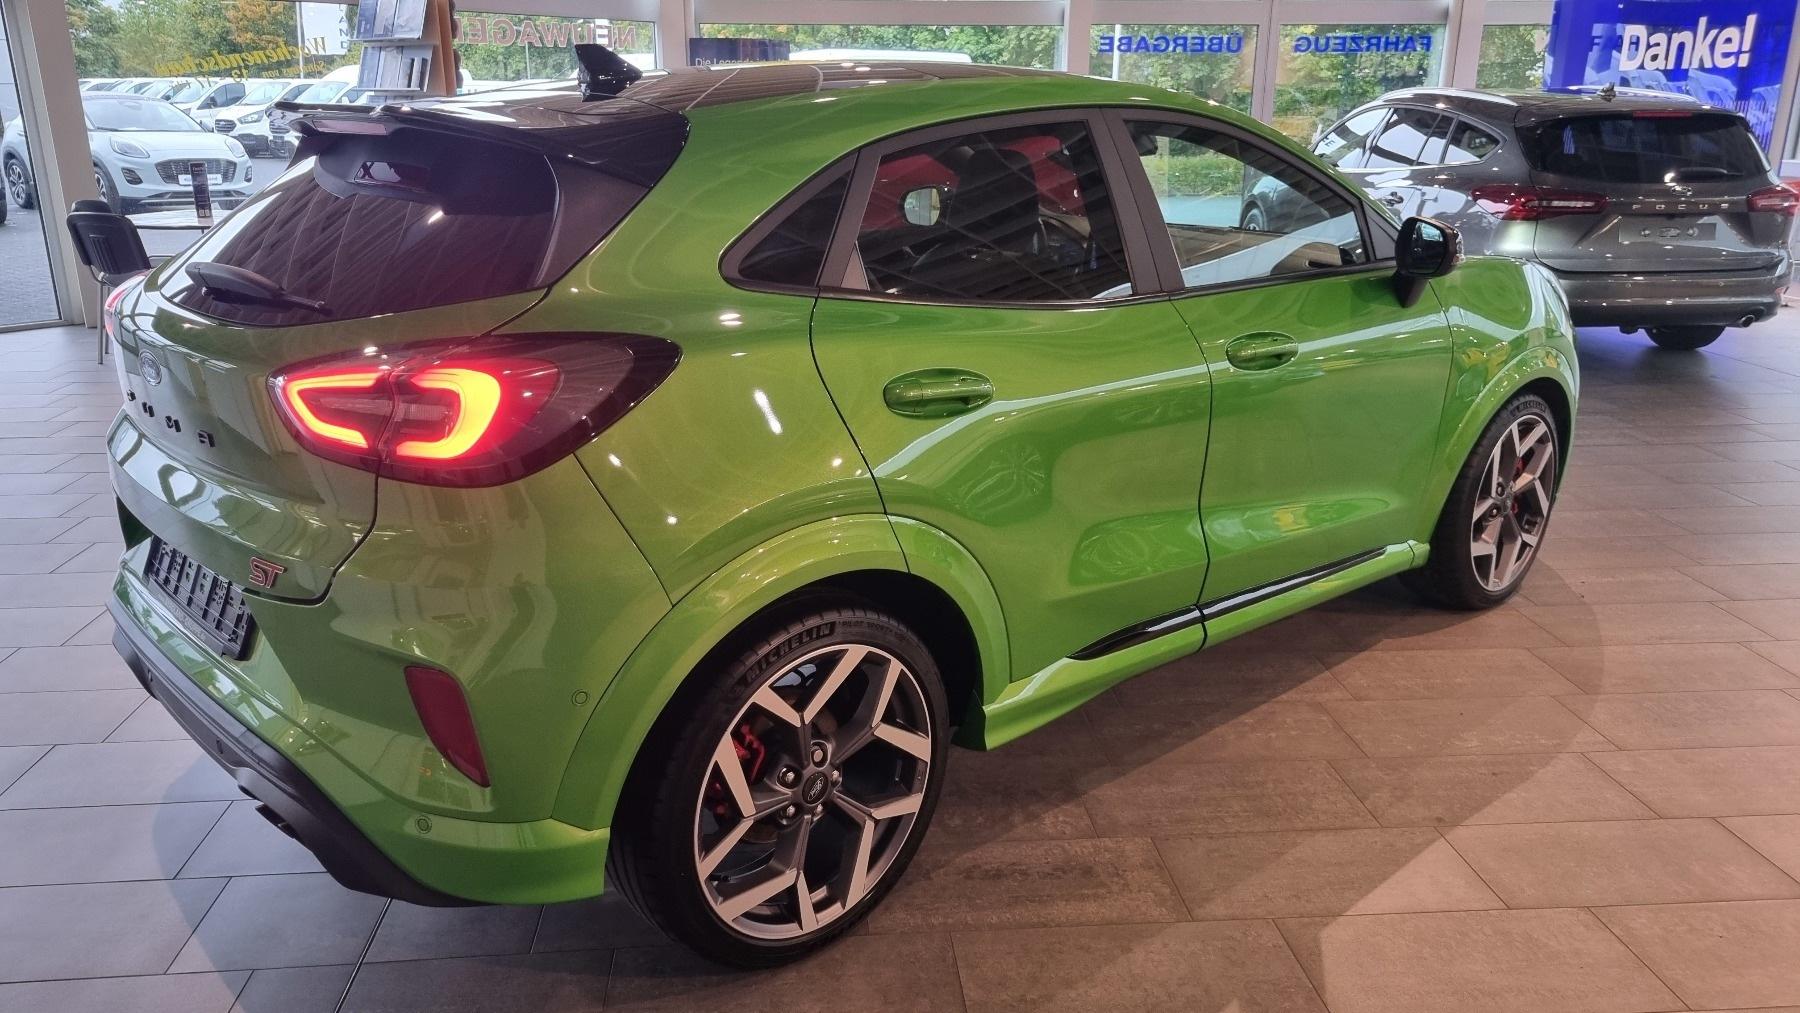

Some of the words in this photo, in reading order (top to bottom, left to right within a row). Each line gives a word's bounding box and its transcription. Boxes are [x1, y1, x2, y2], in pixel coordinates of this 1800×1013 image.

[1619, 14, 1758, 71] Danke!
[249, 556, 284, 589] ST
[745, 623, 832, 681] MICHELIN
